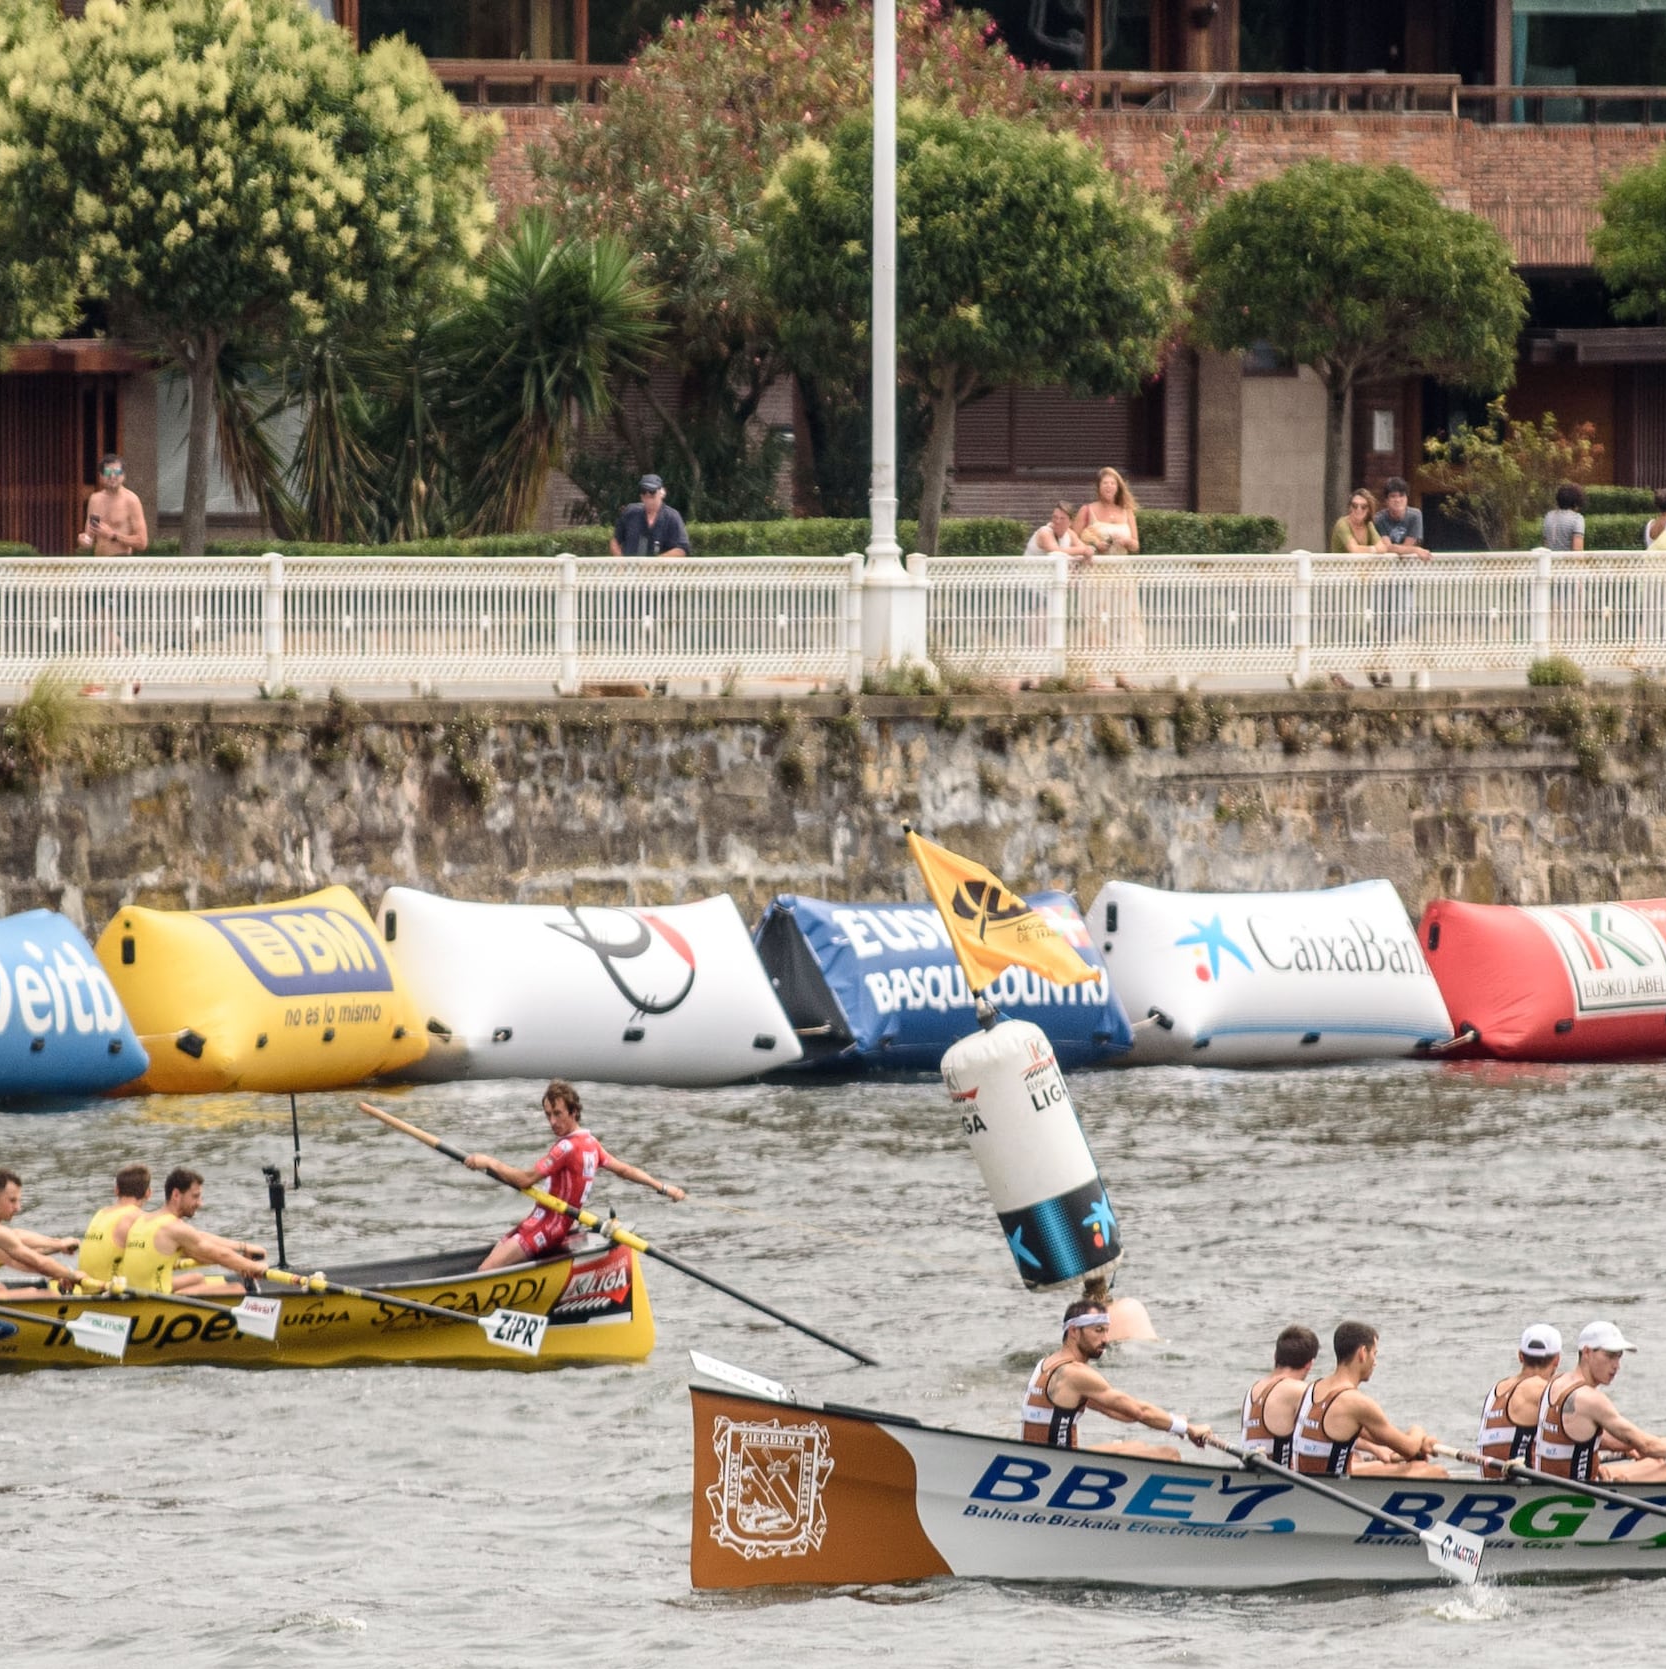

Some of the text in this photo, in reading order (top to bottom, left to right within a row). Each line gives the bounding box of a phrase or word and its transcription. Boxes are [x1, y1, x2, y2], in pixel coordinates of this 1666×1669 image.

[1247, 916, 1431, 978] CaixaBan
[15, 941, 122, 1034] eitb
[865, 965, 974, 1014] BASQU
[1584, 978, 1627, 998] EUSKO
[284, 1000, 381, 1027] no es lo mismo
[1030, 1084, 1066, 1112] LIG
[588, 1267, 627, 1293] LIGA
[284, 1310, 350, 1326] URMA
[740, 1431, 805, 1447] ZIERBENA
[962, 1503, 1248, 1539] Bahía de Bizkaia Electricidad
[1452, 1543, 1479, 1567] MATRA
[1521, 1539, 1566, 1550] Gas
